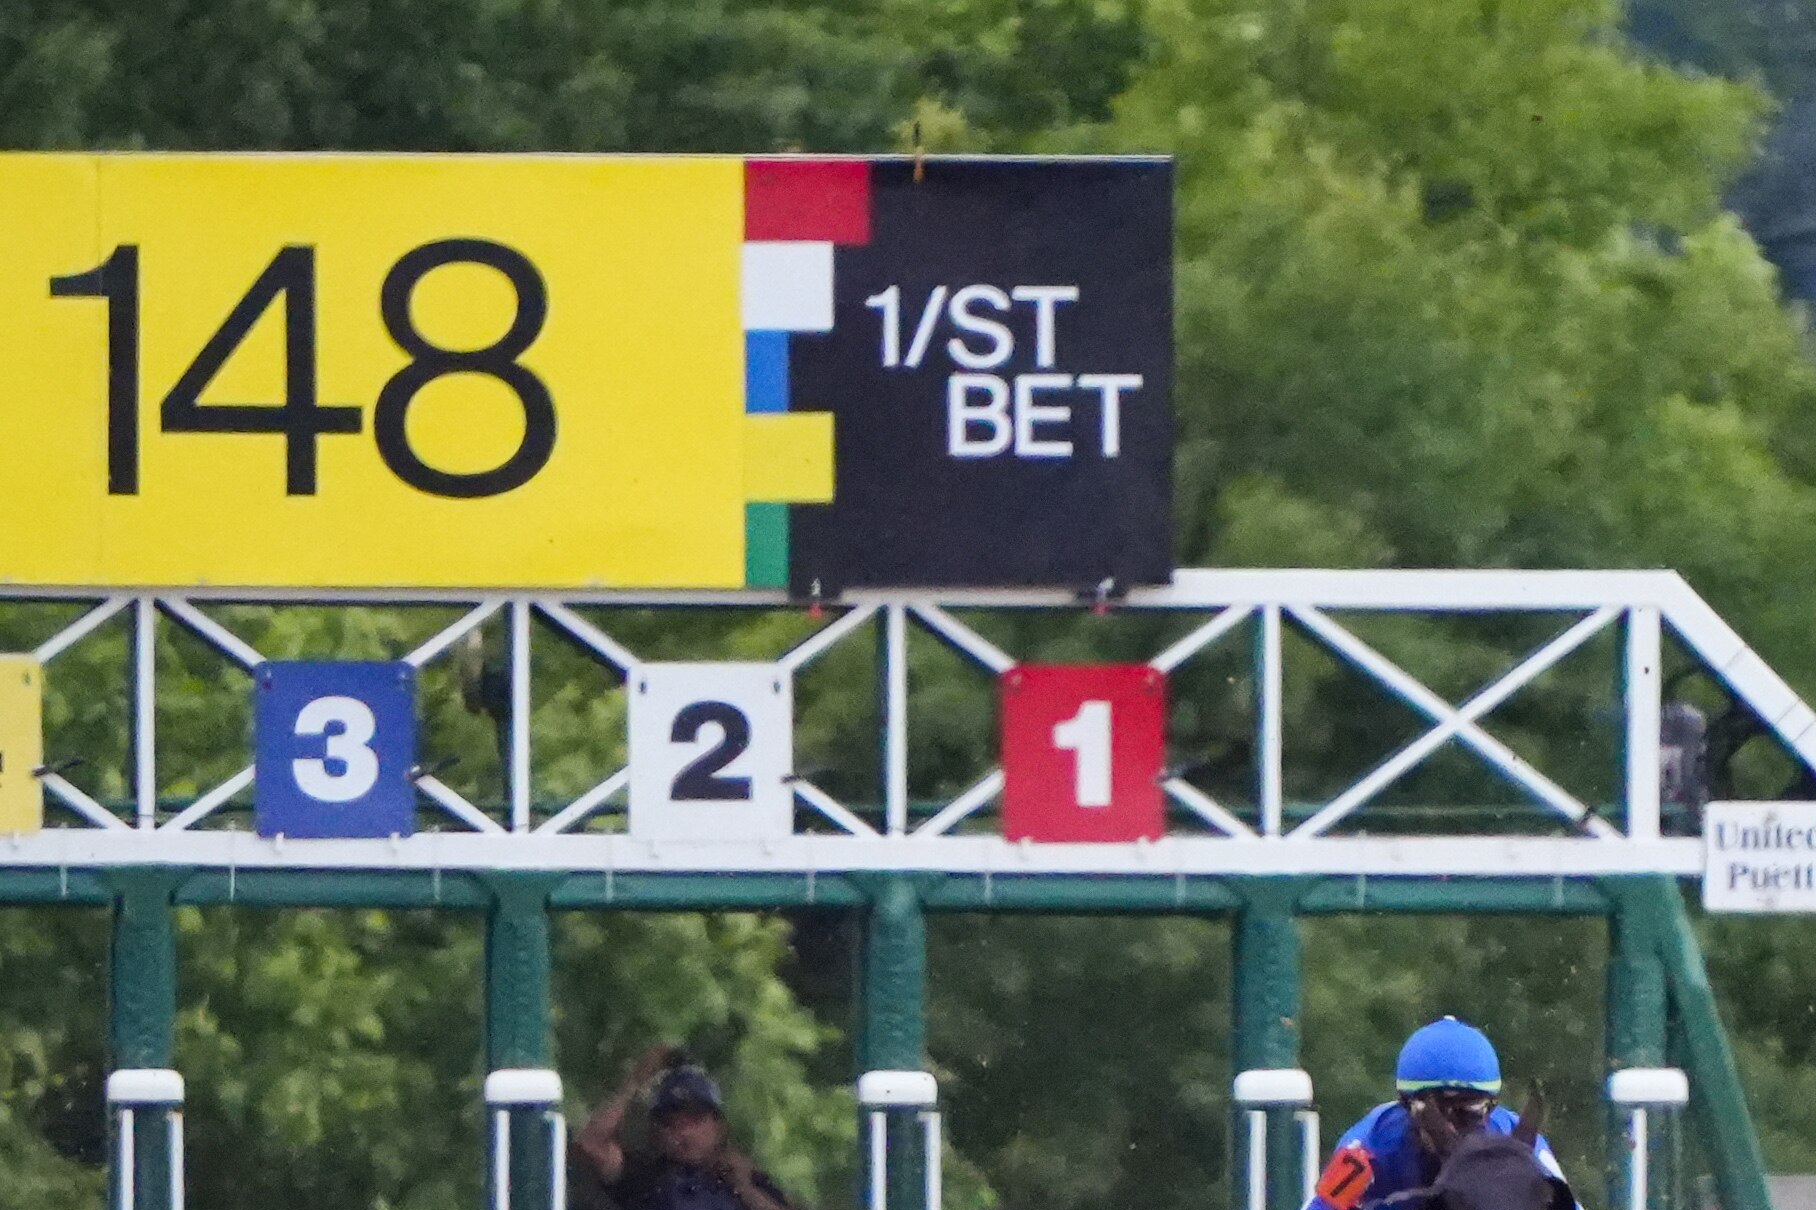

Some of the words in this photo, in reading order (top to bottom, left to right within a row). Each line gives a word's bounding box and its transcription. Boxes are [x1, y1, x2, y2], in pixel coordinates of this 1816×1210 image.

[48, 237, 559, 499] 148
[864, 283, 1081, 369] 1/ST
[947, 373, 1144, 458] BET
[291, 694, 380, 803] 3
[669, 700, 754, 800] 2
[1052, 700, 1114, 807] 1
[1728, 861, 1815, 890] Puett
[1329, 1153, 1366, 1198] 7
